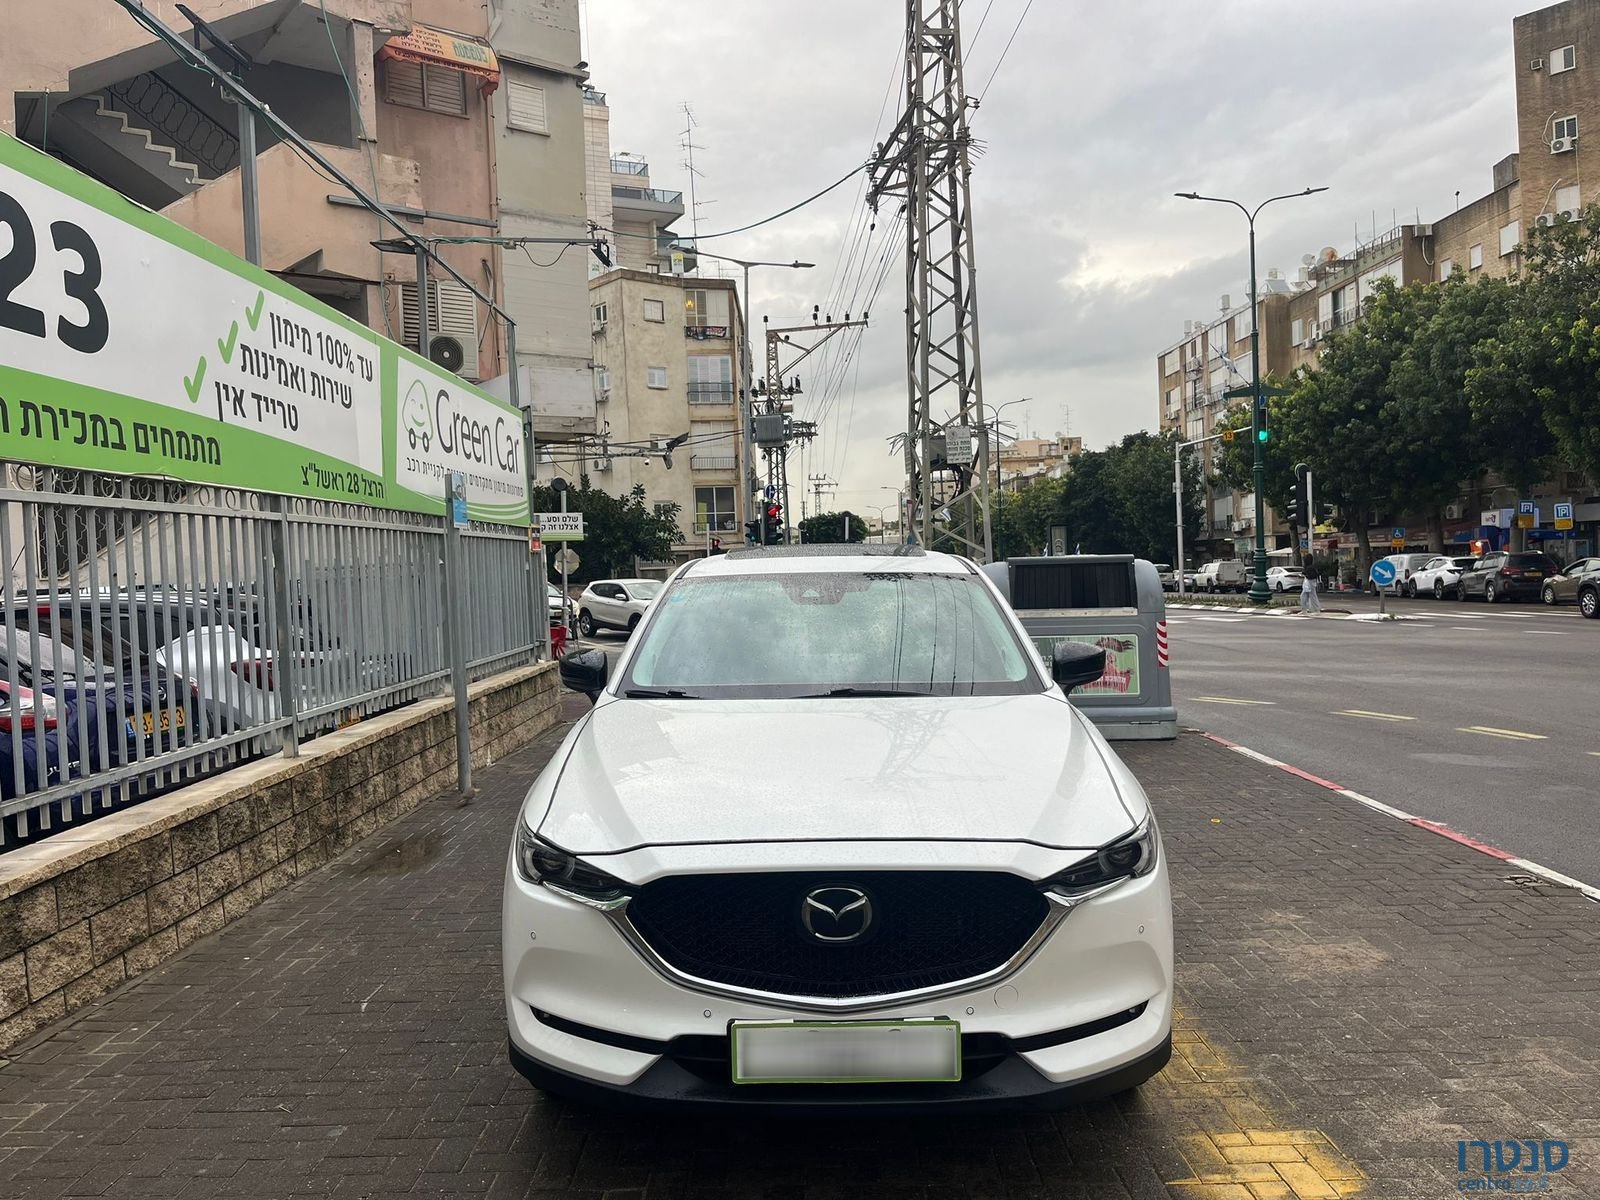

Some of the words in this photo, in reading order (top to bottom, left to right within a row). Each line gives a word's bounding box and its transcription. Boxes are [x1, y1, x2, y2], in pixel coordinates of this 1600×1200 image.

[270, 312, 312, 356] מימון
[317, 332, 355, 374] 100%
[240, 343, 307, 393] ואמינות
[357, 354, 373, 382] עד
[215, 381, 247, 422] אין
[310, 371, 352, 409] שירות
[19, 400, 127, 451] במכירת
[251, 392, 299, 431] טרייד
[133, 422, 222, 465] מתמחים
[435, 389, 493, 466] Green
[495, 416, 519, 475] Car
[346, 471, 360, 494] 28
[406, 456, 421, 473] רכב
[422, 461, 445, 481] לקניית
[361, 473, 384, 499] הרצל
[558, 523, 579, 531] אצלנו
[562, 515, 579, 523] שלם
